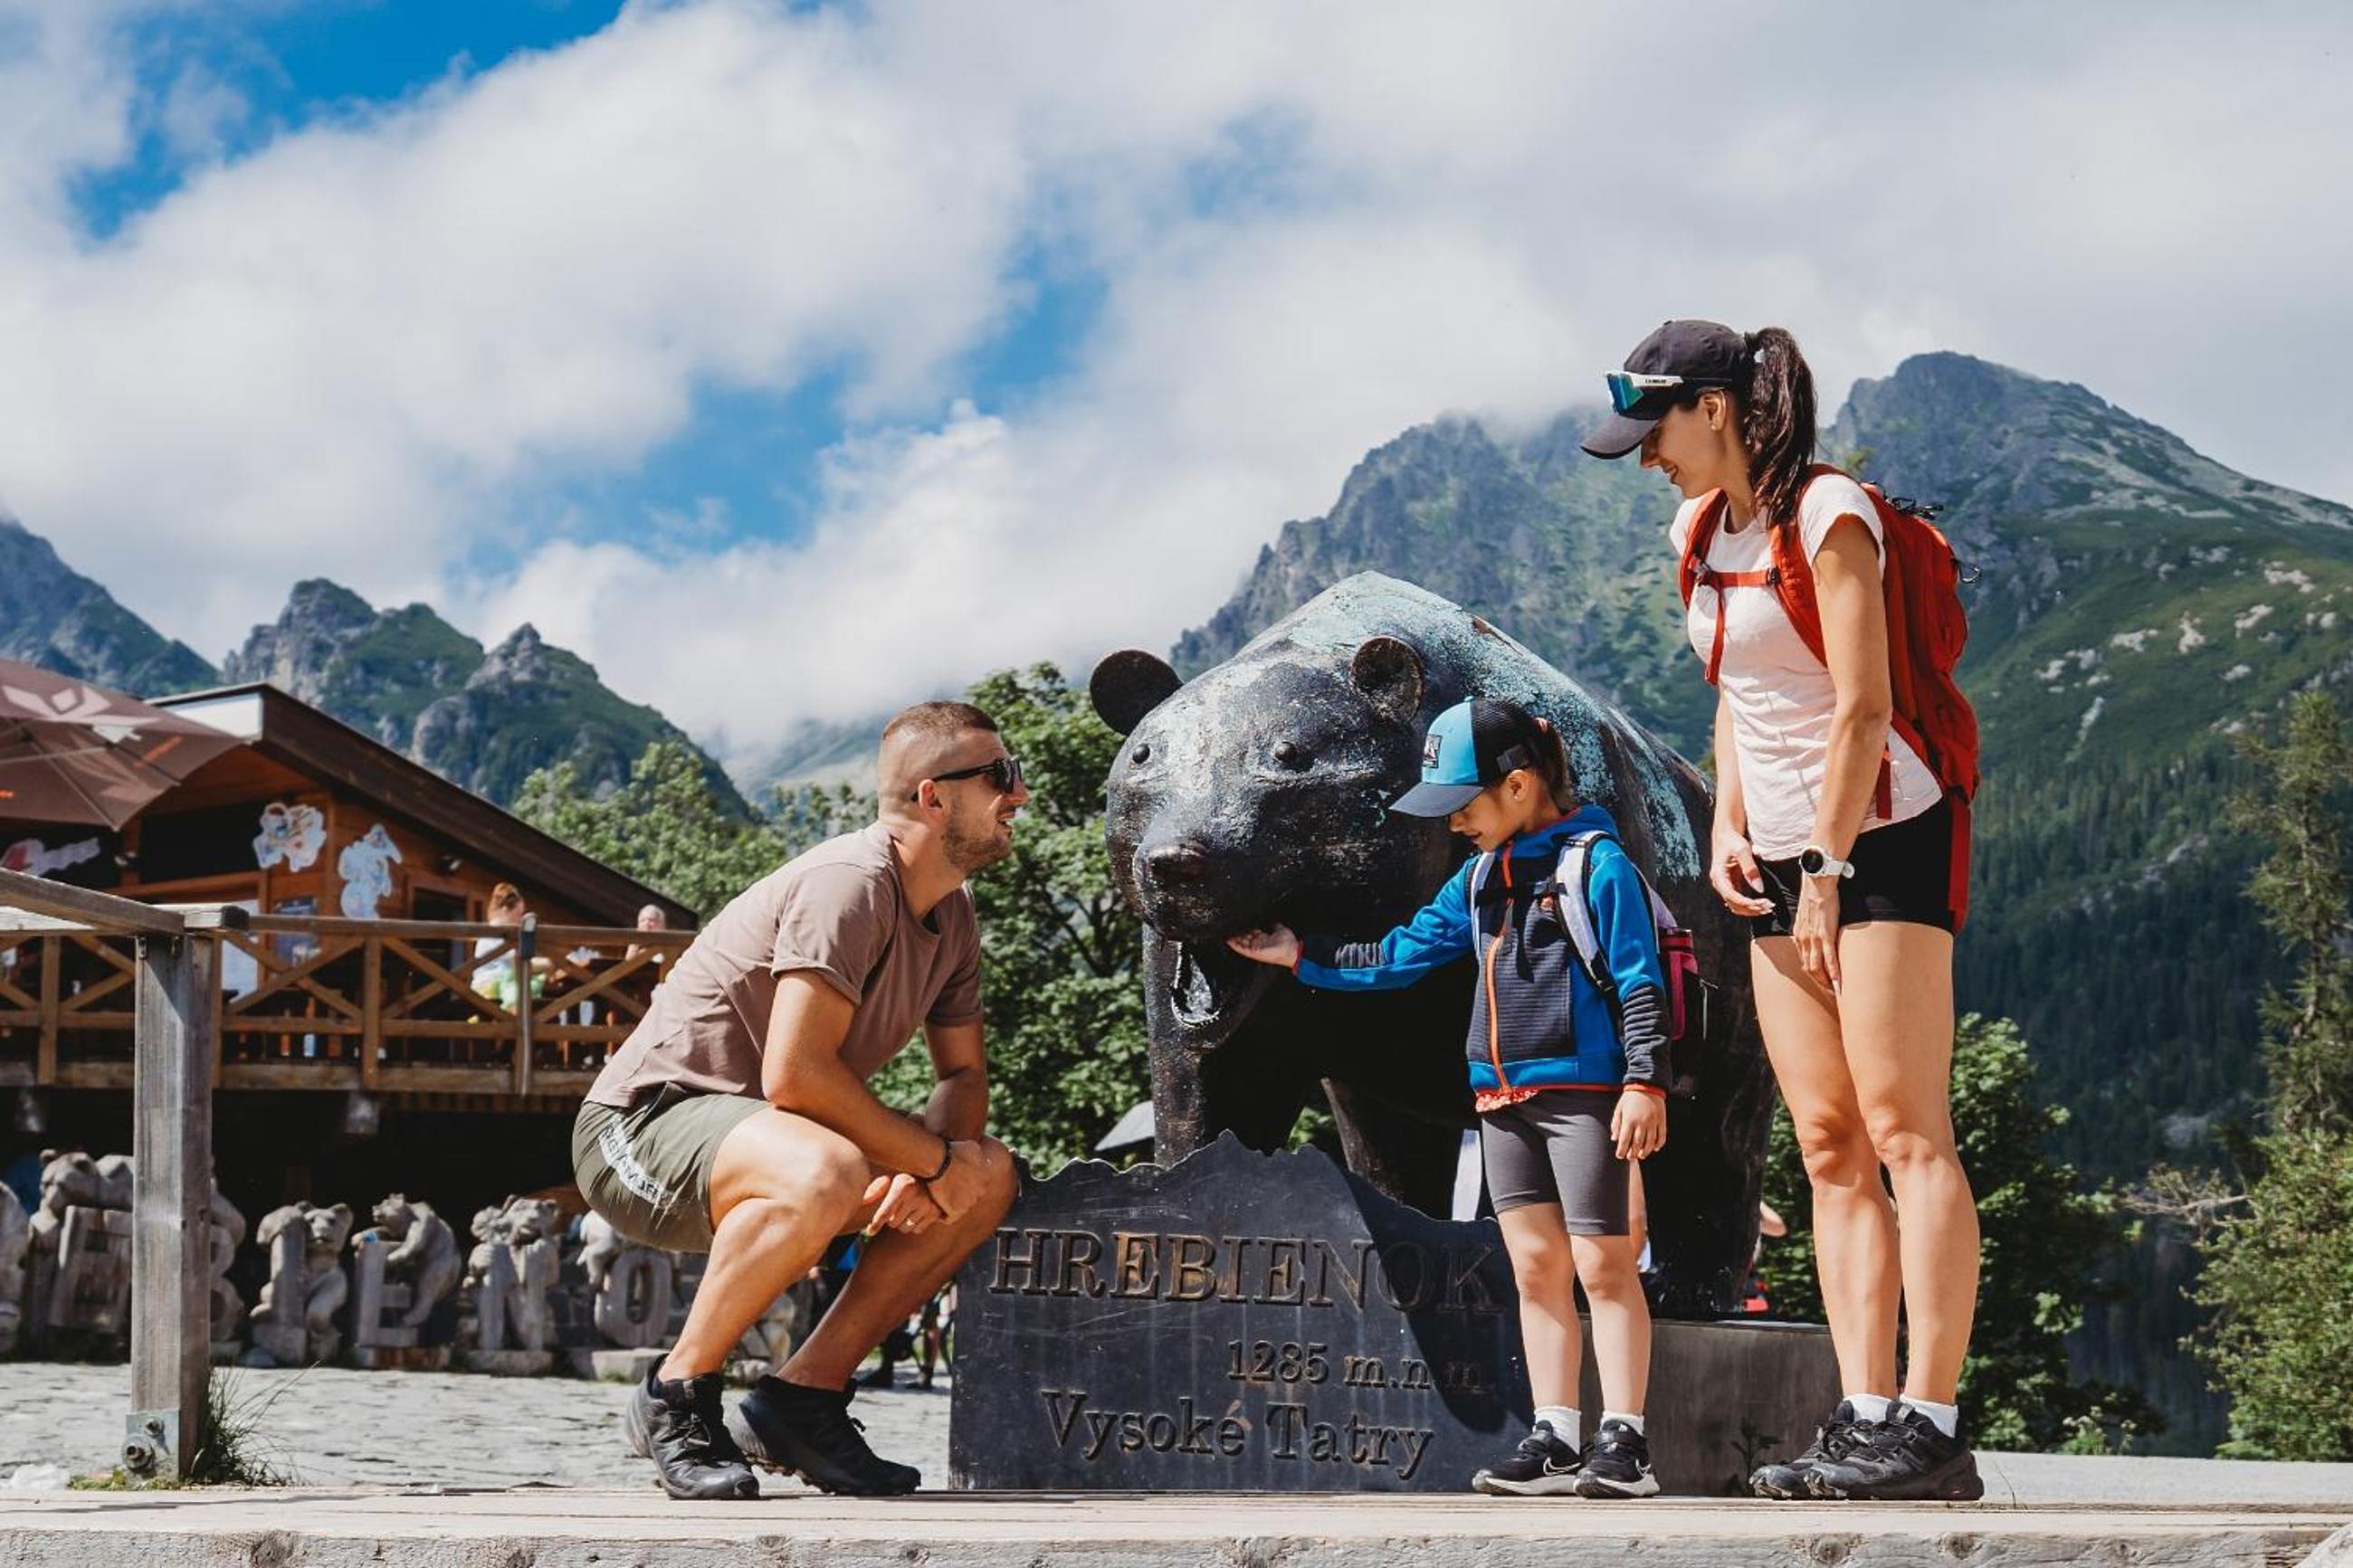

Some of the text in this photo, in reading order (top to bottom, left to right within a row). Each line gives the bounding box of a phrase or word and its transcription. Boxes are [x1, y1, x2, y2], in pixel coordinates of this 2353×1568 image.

[987, 1226, 1506, 1315] HREBIENOK
[1226, 1340, 1329, 1384] 1285
[1040, 1390, 1436, 1481] Vysoké Tatry
